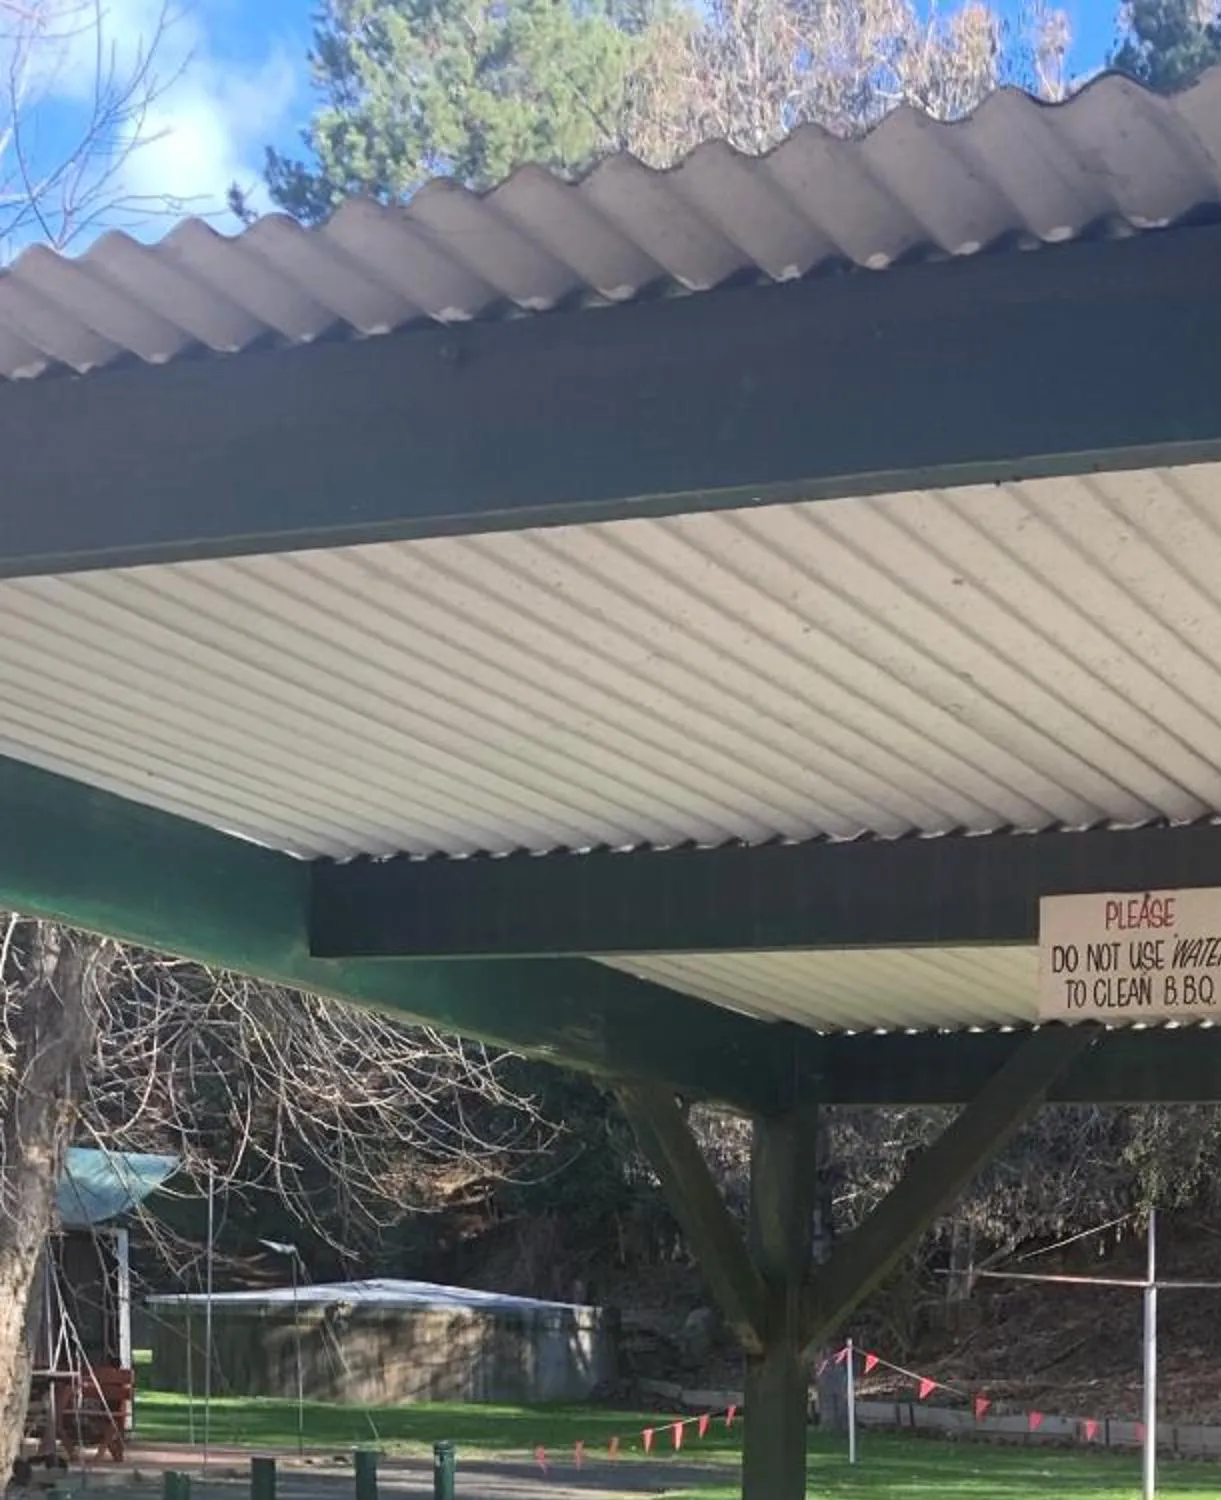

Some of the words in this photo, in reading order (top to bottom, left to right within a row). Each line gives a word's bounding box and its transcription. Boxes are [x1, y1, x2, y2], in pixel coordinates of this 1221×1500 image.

[1105, 897, 1176, 930] PLEASE
[1052, 945, 1079, 973] DO
[1087, 943, 1121, 971] NOT
[1129, 940, 1165, 970] USE
[1065, 979, 1087, 1008] TO
[1093, 975, 1151, 1007] CLEAN
